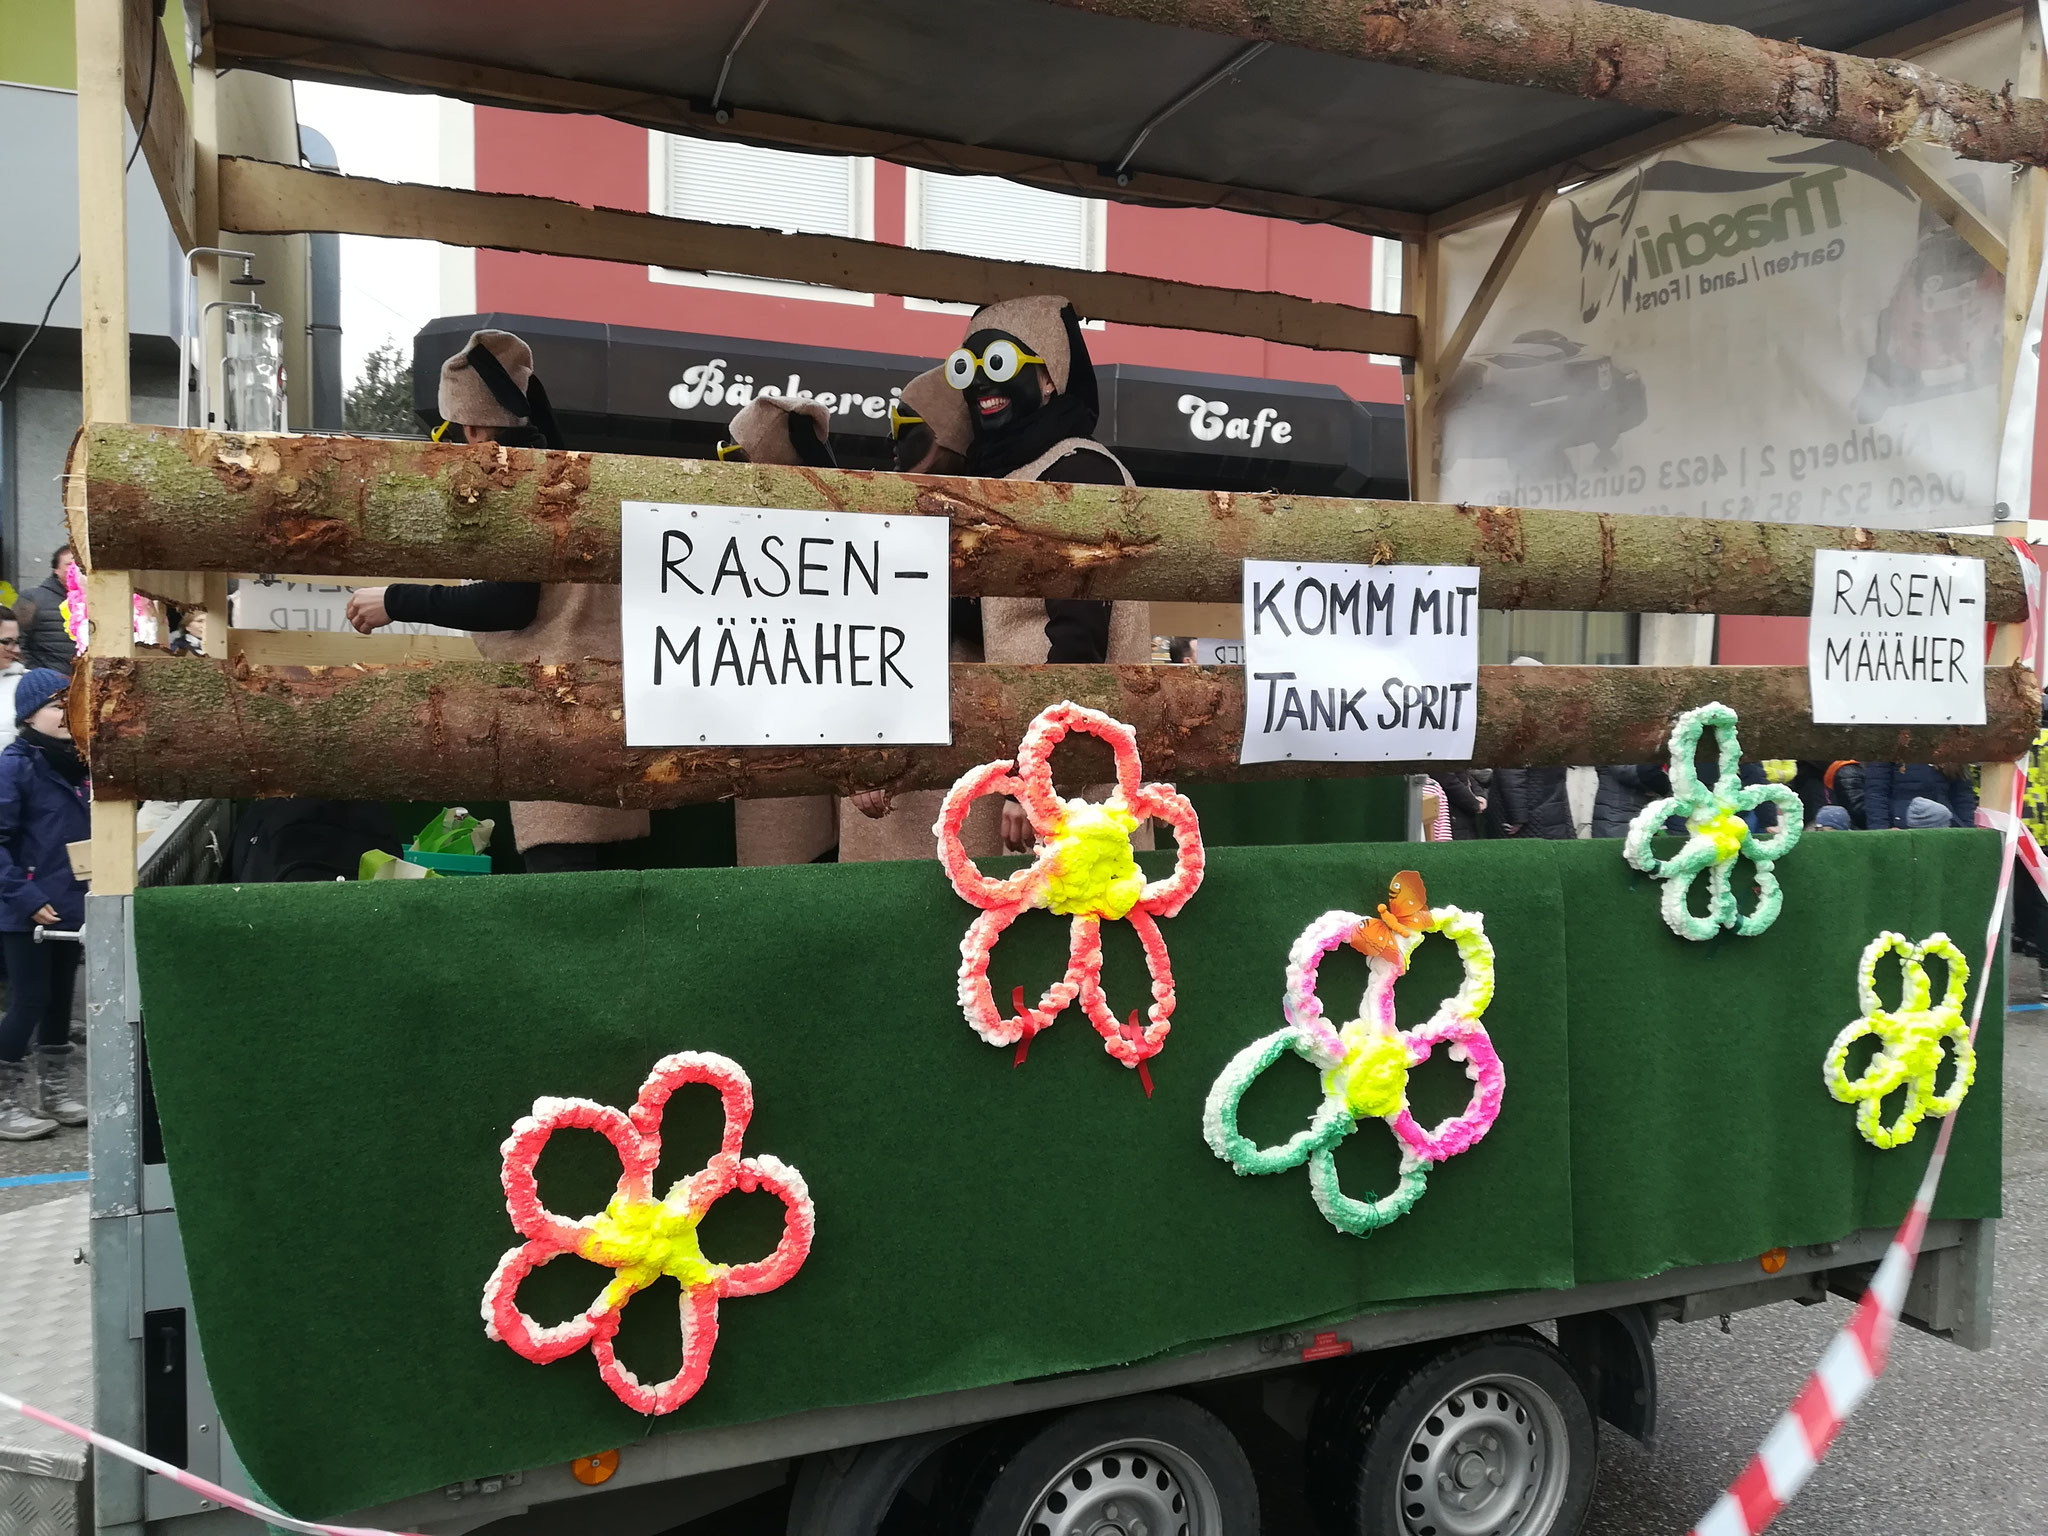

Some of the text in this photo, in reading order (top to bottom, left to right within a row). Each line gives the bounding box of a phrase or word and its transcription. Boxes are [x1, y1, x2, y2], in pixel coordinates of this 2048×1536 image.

[1177, 393, 1293, 449] Cafe
[661, 529, 929, 598] RASEN-
[1833, 568, 1976, 618] RASEN-
[1253, 576, 1478, 638] KOMM MIT
[653, 616, 914, 690] MÄÄÄHER
[1825, 630, 1969, 684] MÄÄÄHER
[1253, 671, 1473, 734] TANK SPRIT
